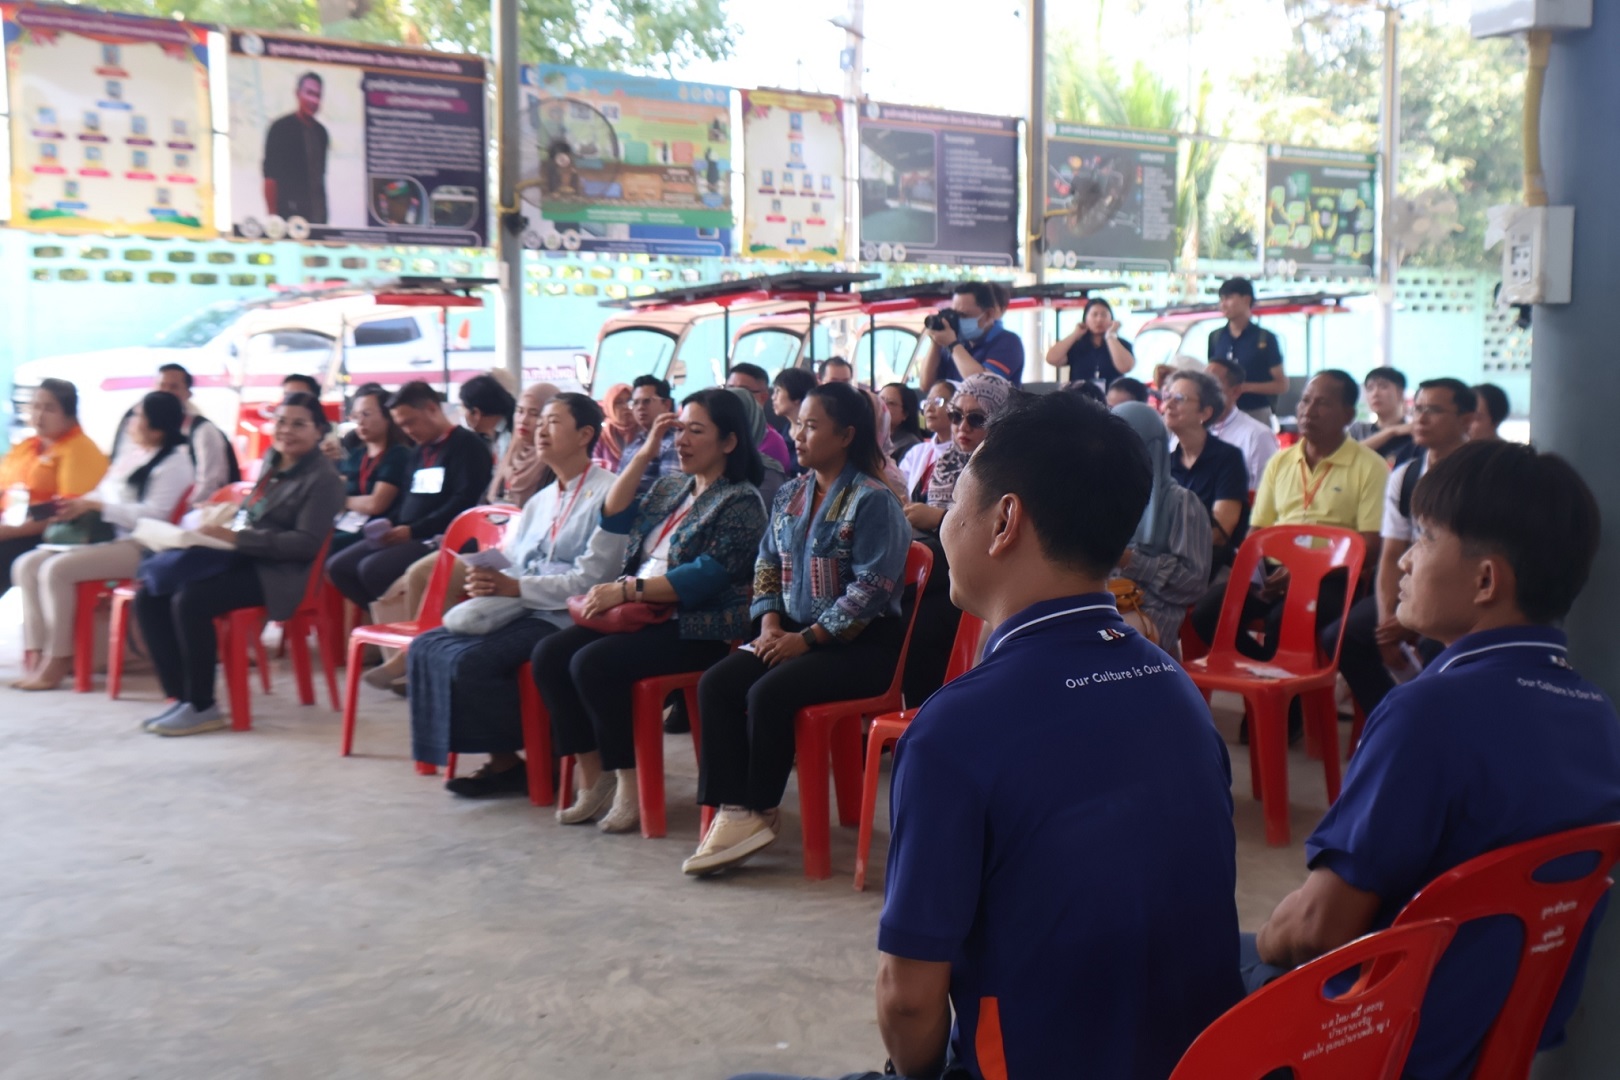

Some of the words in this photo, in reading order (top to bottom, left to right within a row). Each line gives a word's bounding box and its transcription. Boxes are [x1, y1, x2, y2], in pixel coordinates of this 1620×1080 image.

[1065, 677, 1089, 688] Our
[1092, 671, 1132, 682] Culture
[1143, 664, 1161, 675] Our
